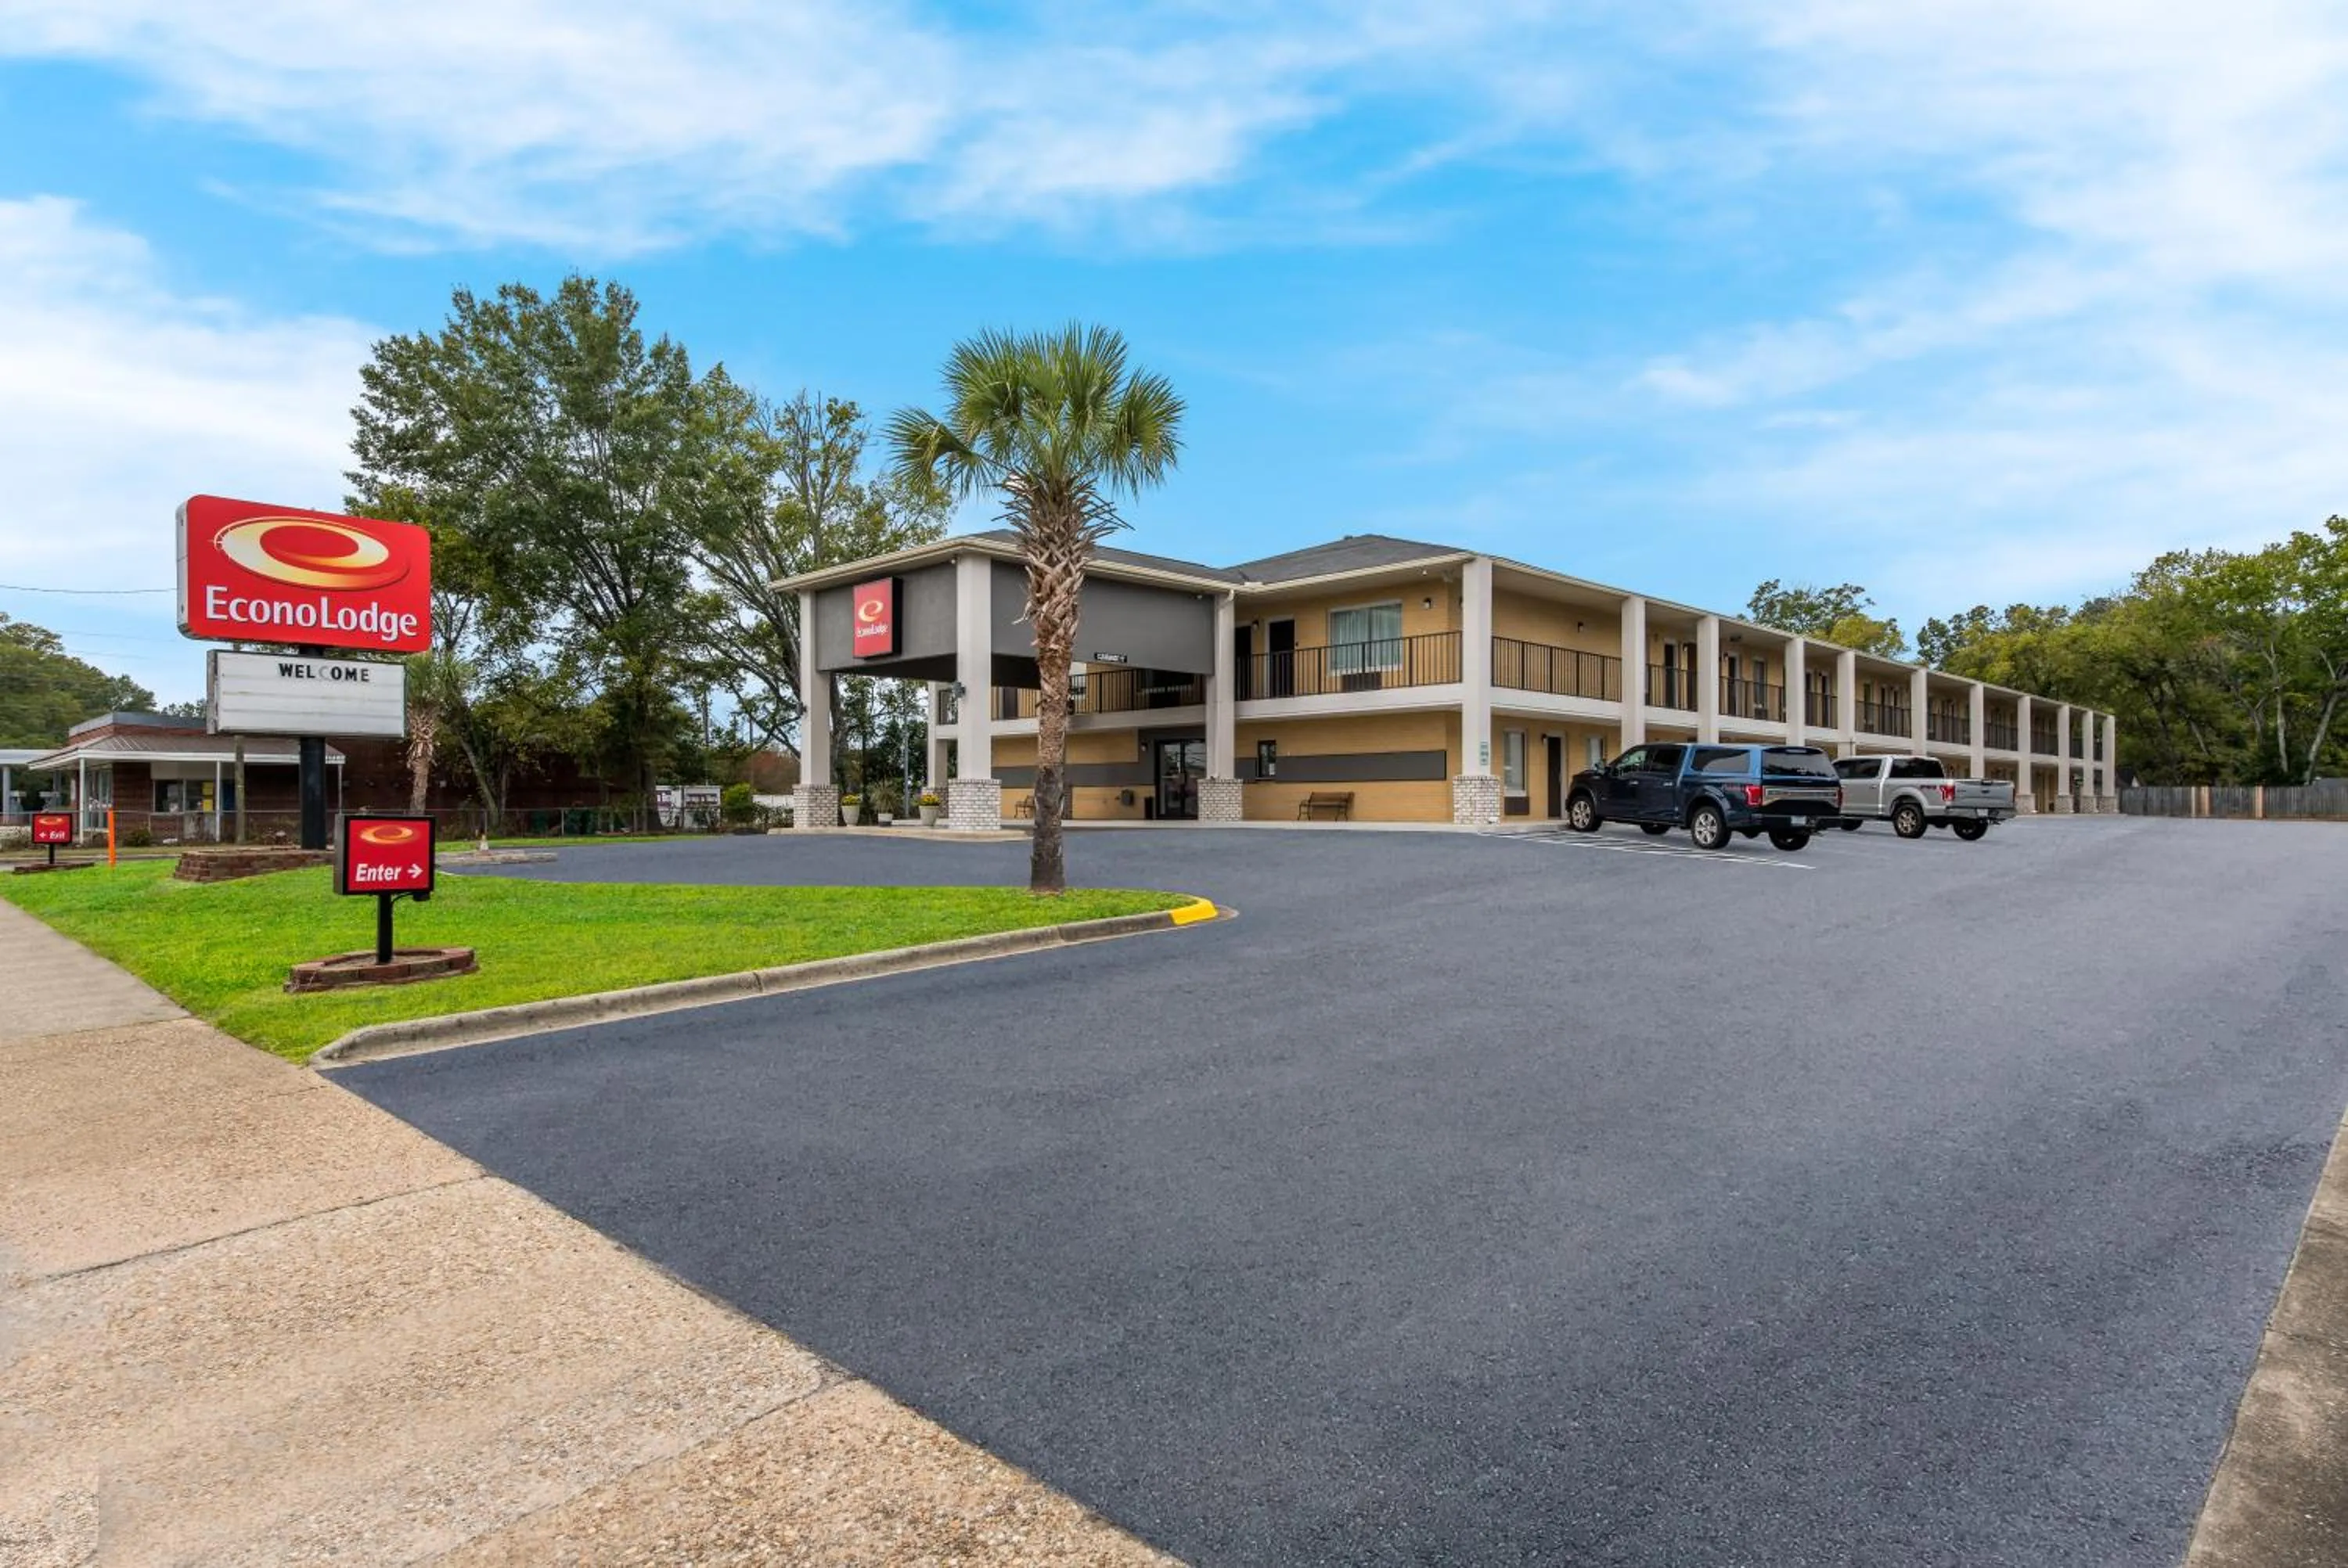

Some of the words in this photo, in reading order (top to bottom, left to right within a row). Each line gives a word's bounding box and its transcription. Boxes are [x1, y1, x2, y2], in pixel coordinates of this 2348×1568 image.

[206, 584, 418, 641] EconoLodge
[279, 663, 370, 682] WELCOME
[355, 862, 403, 883] Enter
